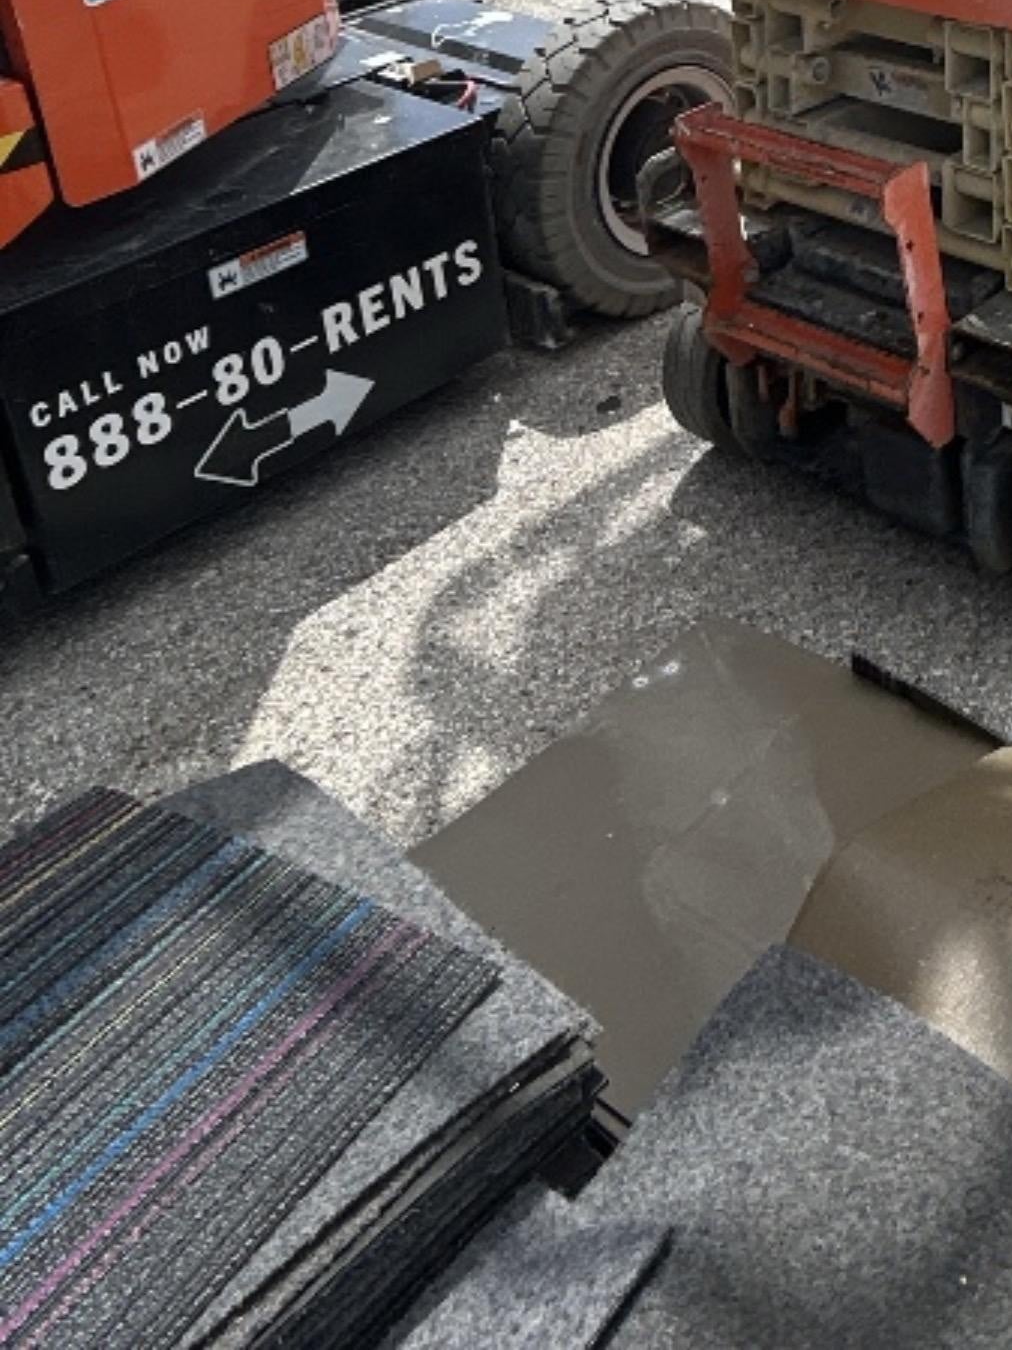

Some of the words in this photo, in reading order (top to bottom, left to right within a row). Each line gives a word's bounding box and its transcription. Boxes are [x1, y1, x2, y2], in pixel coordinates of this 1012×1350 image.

[29, 371, 123, 428] CALL
[136, 326, 211, 379] NOW
[43, 239, 484, 490] 888-80-RENTS
